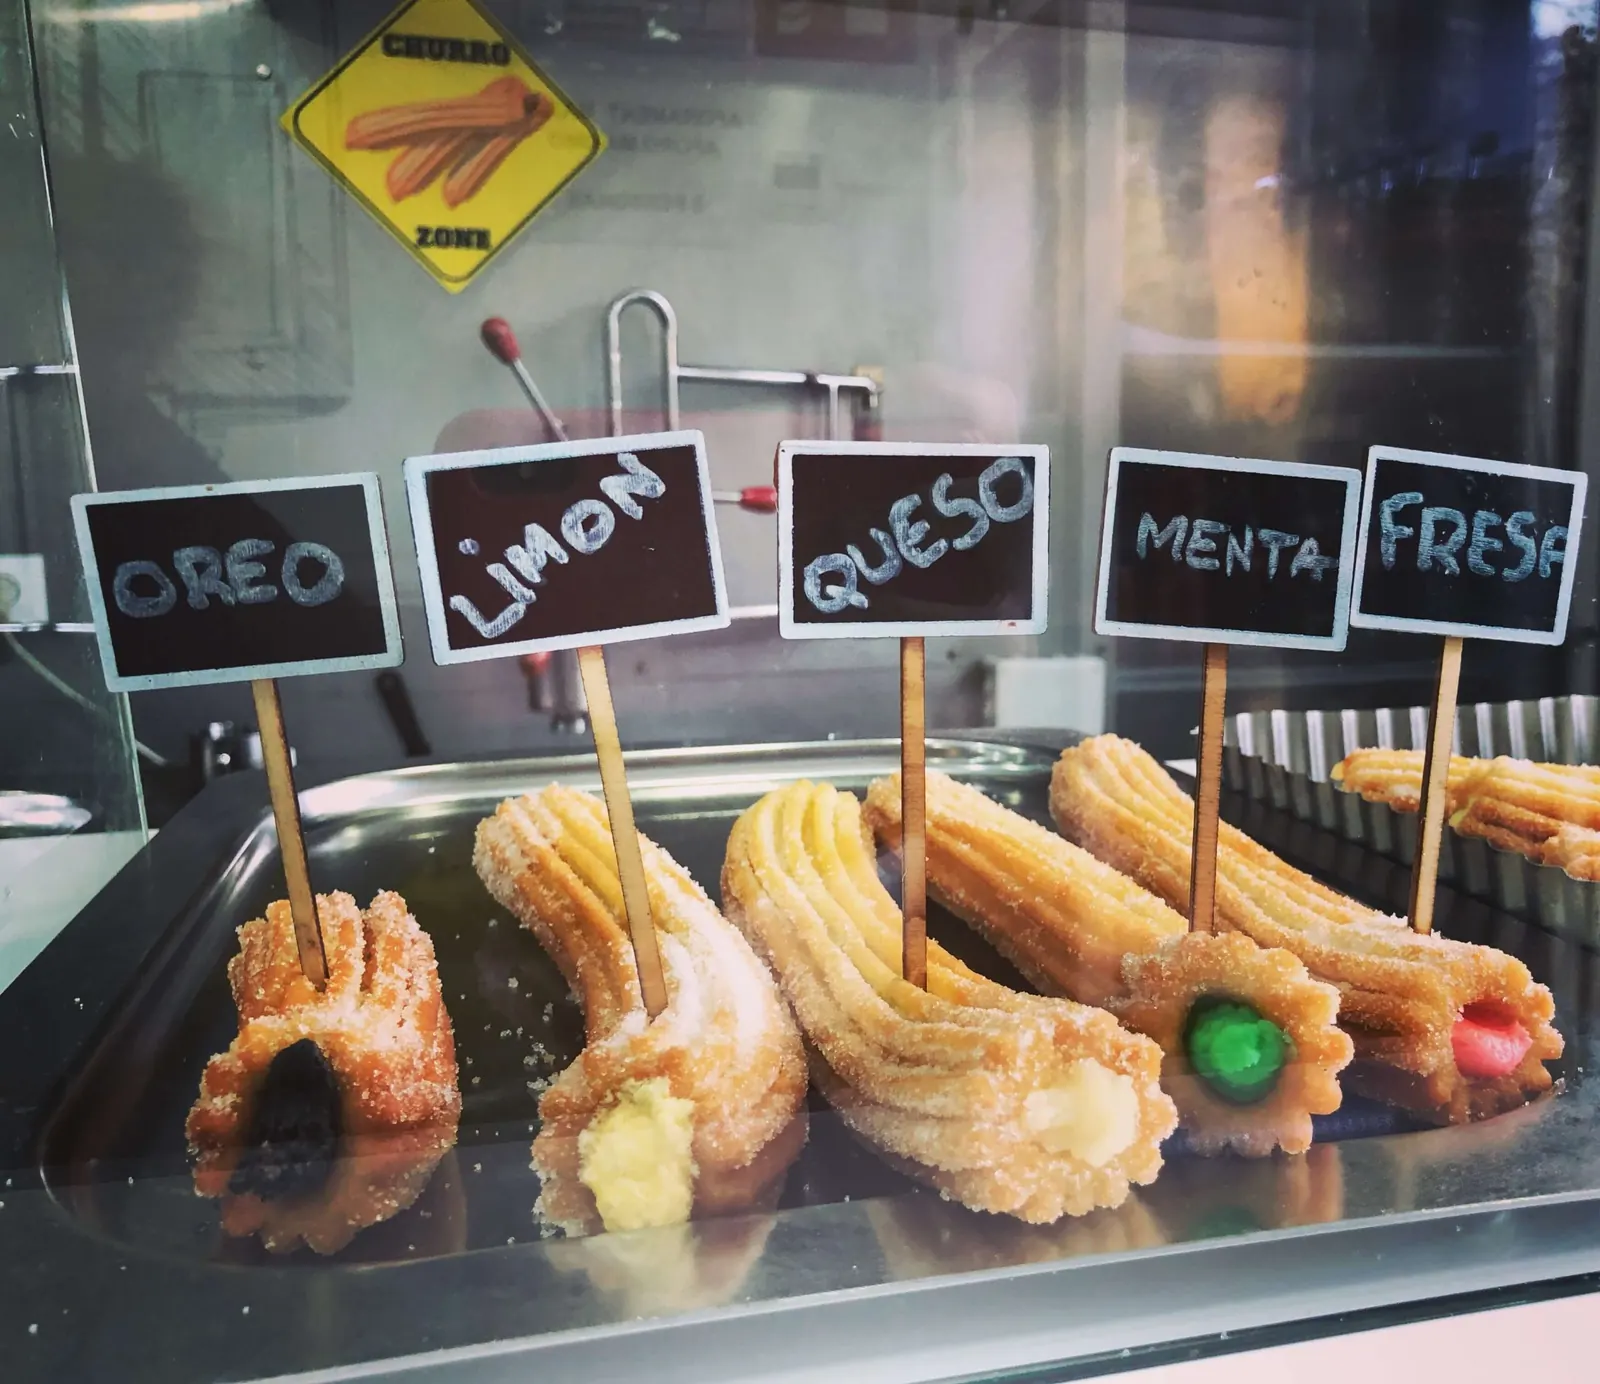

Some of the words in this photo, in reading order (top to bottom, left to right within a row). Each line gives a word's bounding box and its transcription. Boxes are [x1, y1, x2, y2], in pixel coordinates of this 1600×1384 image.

[382, 34, 511, 66] CHURRO
[416, 226, 490, 249] ZONE
[804, 457, 1034, 613] QUESO
[1136, 512, 1338, 581] MENTA
[1379, 491, 1568, 582] FRESA
[113, 538, 344, 618] OREO
